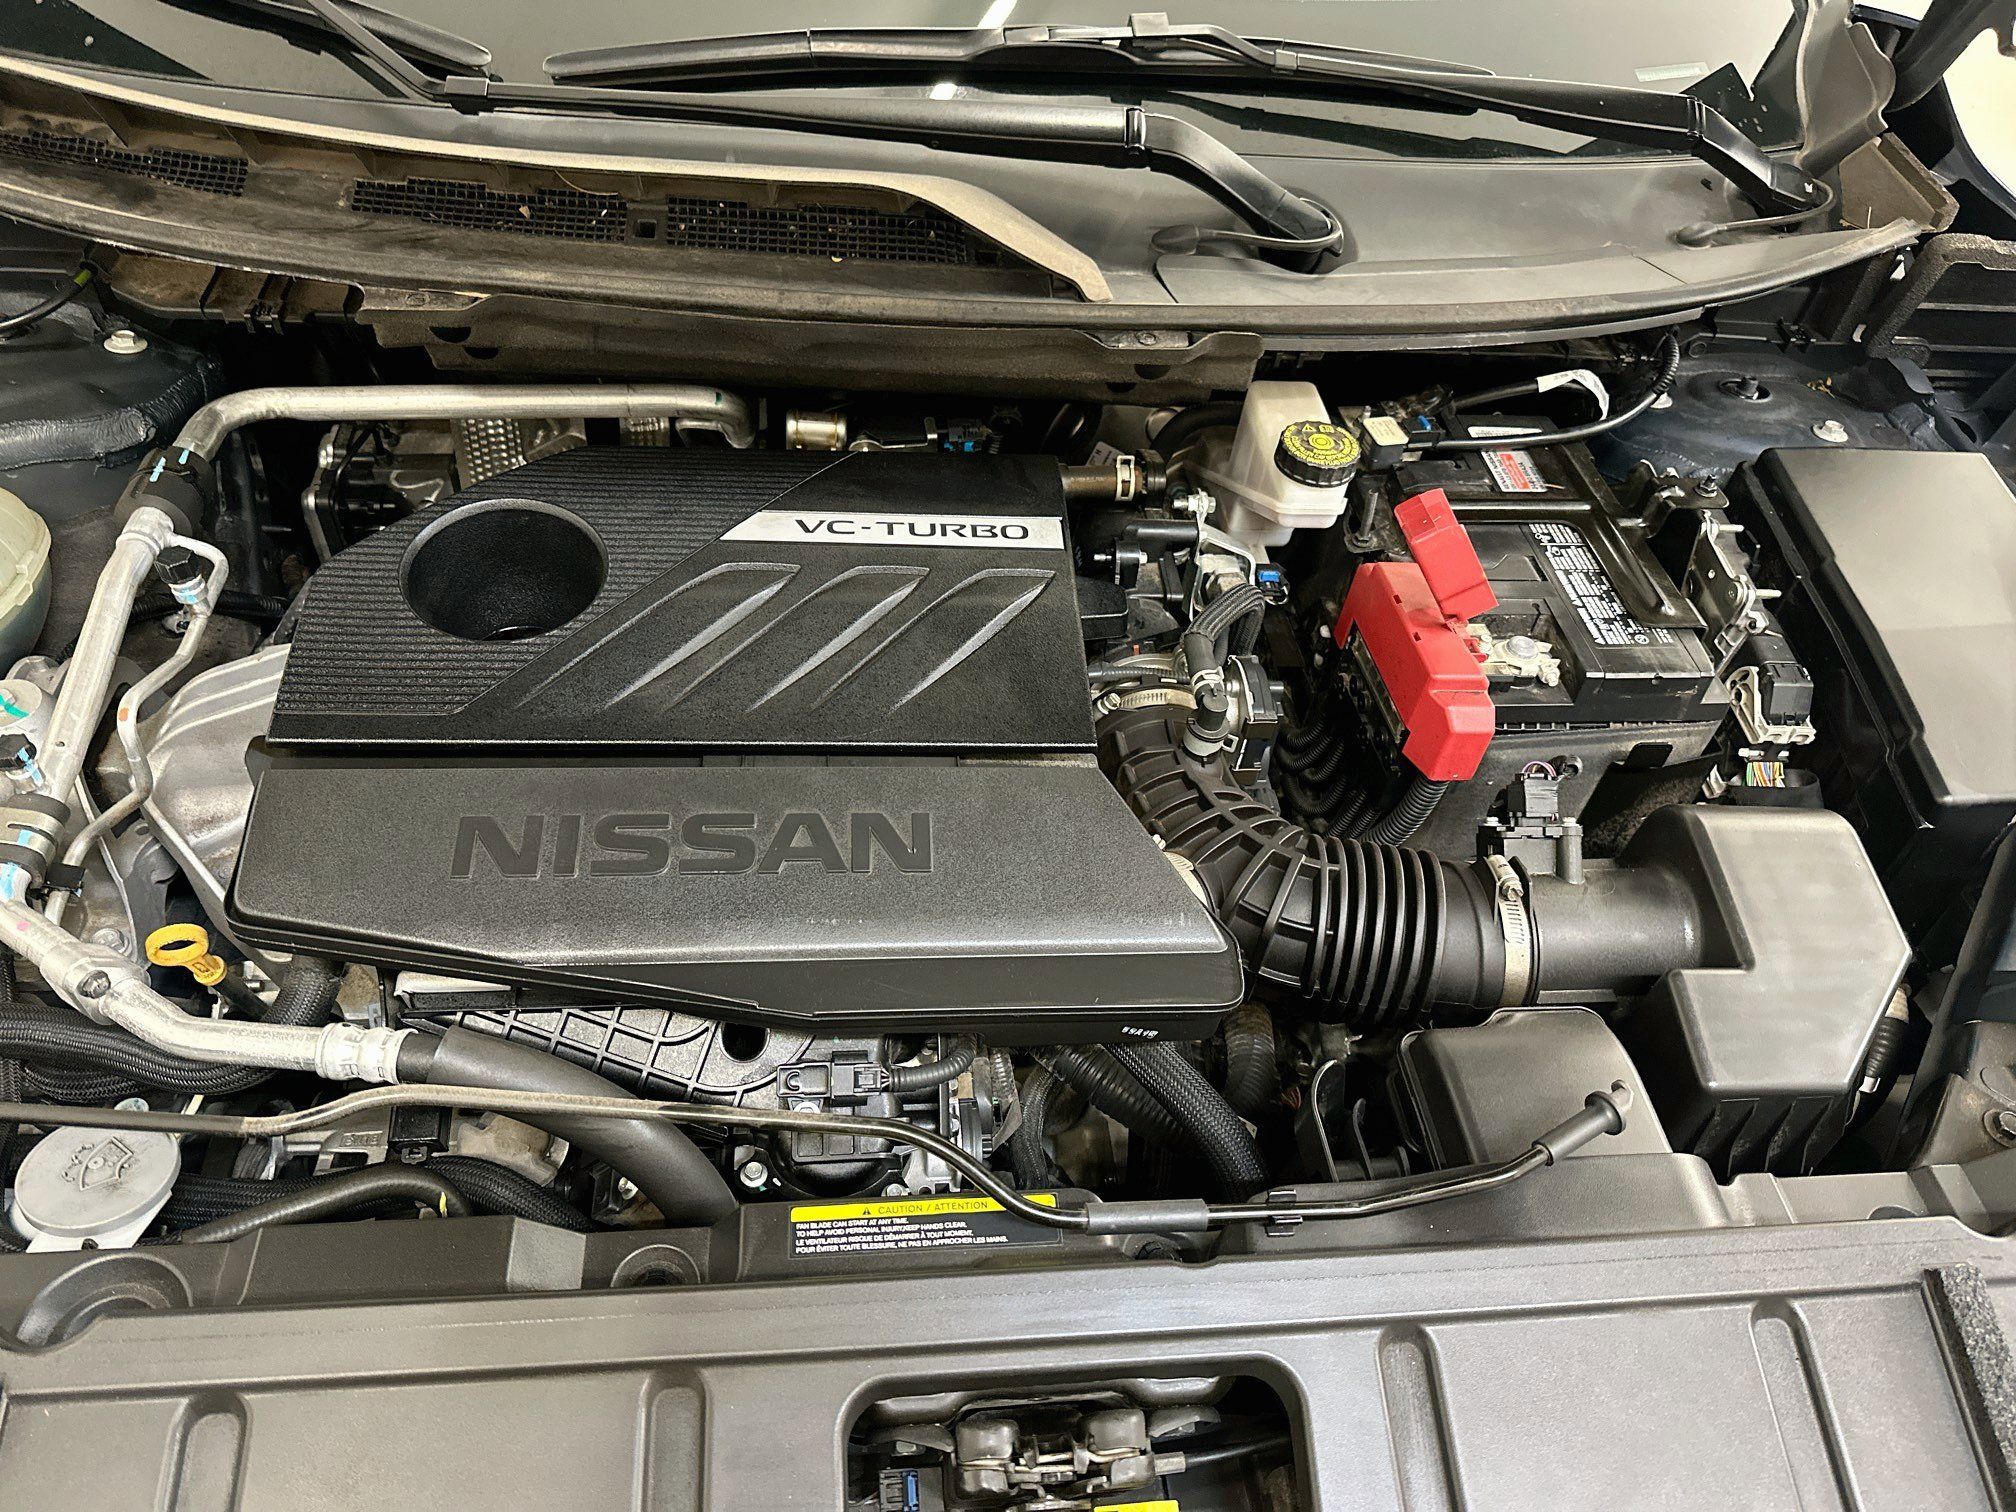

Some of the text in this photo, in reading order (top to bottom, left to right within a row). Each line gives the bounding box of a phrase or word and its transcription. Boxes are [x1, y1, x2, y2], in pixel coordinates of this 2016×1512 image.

[795, 519, 1029, 540] VC-TURBO
[450, 811, 933, 879] NISSAN
[878, 1204, 923, 1214] CAUTION
[934, 1201, 988, 1211] ATTENTION
[805, 1237, 847, 1245] VENTILATEUR
[816, 1244, 839, 1252] ÉVITER
[932, 1237, 973, 1245] APPROCHER
